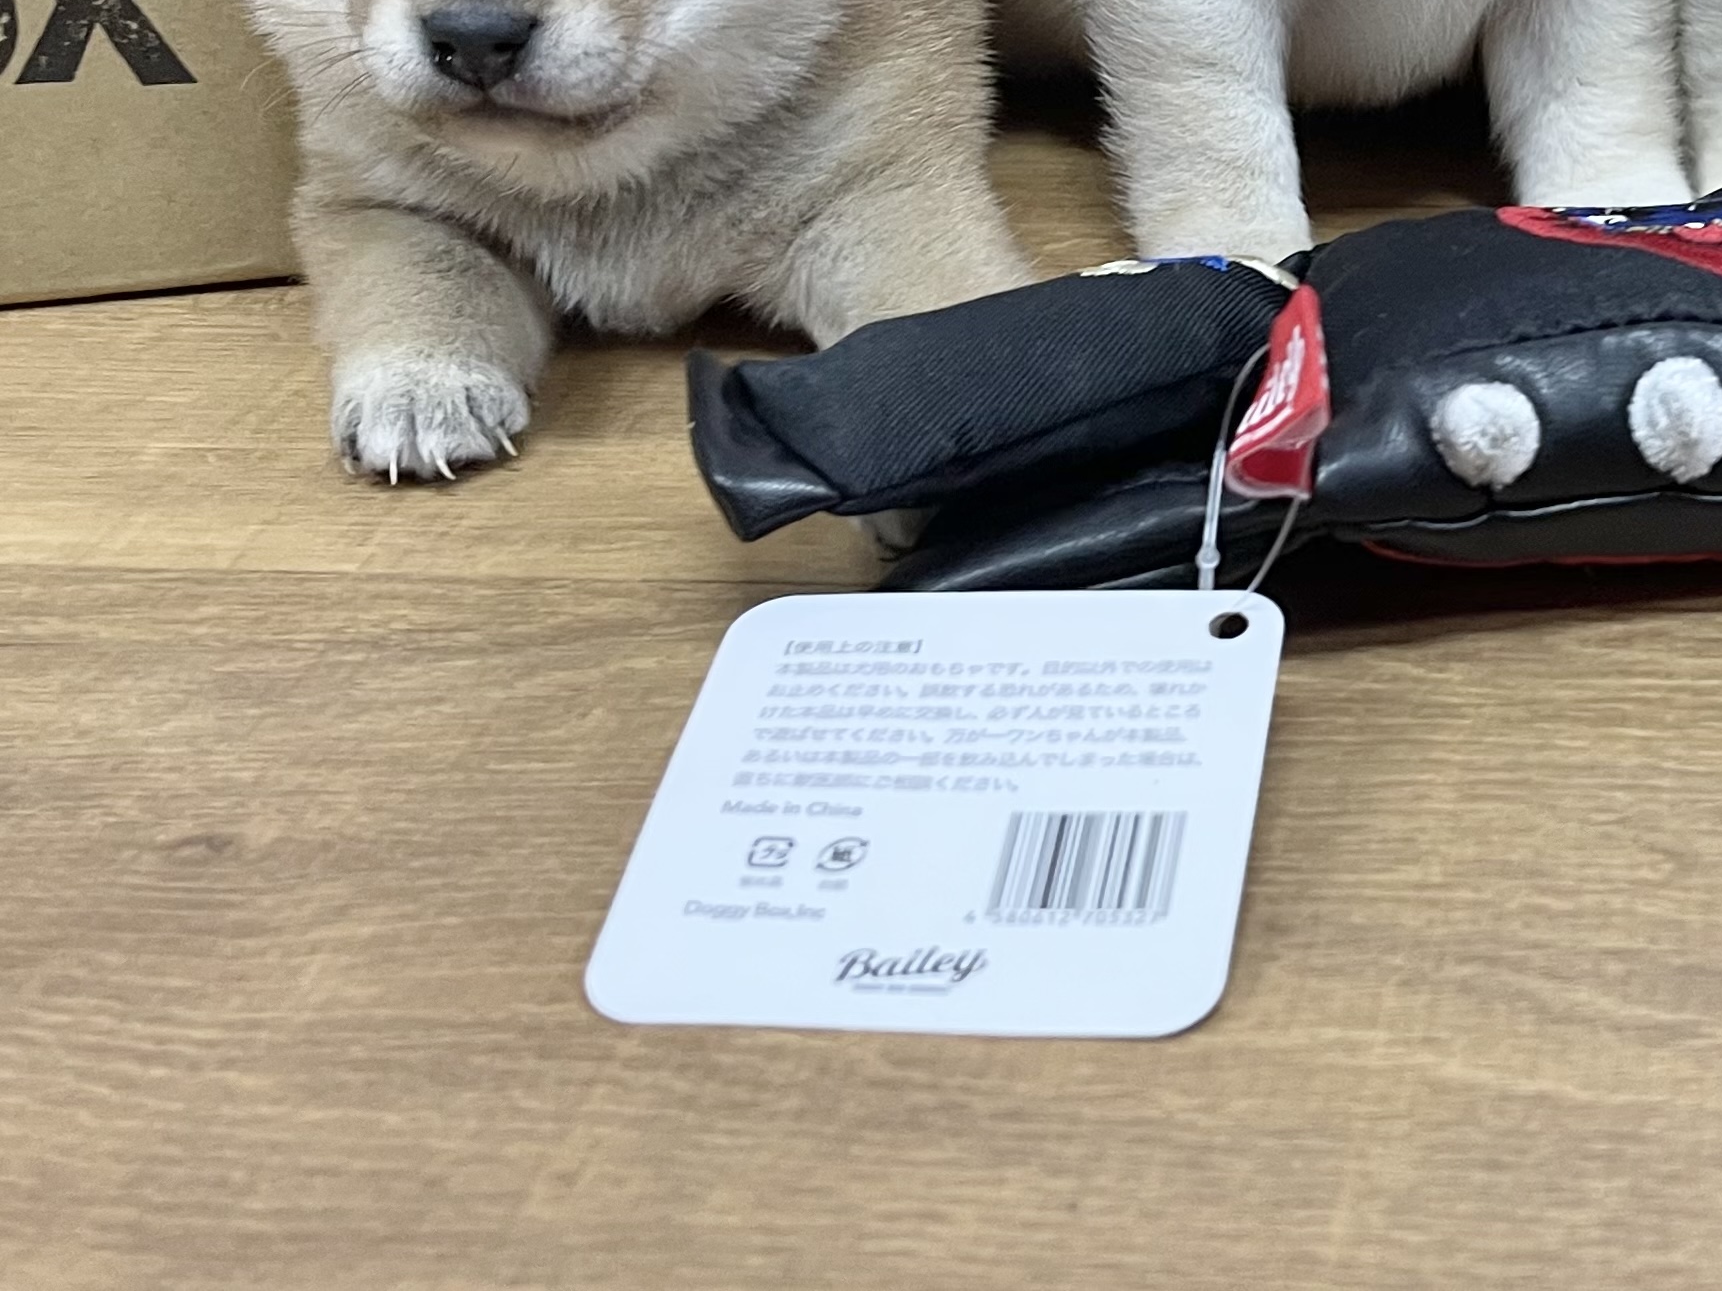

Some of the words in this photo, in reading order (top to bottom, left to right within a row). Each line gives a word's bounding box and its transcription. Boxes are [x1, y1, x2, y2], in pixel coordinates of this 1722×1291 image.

[721, 799, 775, 815] Made
[781, 800, 802, 815] in
[805, 801, 864, 817] China
[834, 945, 989, 984] Bailey
